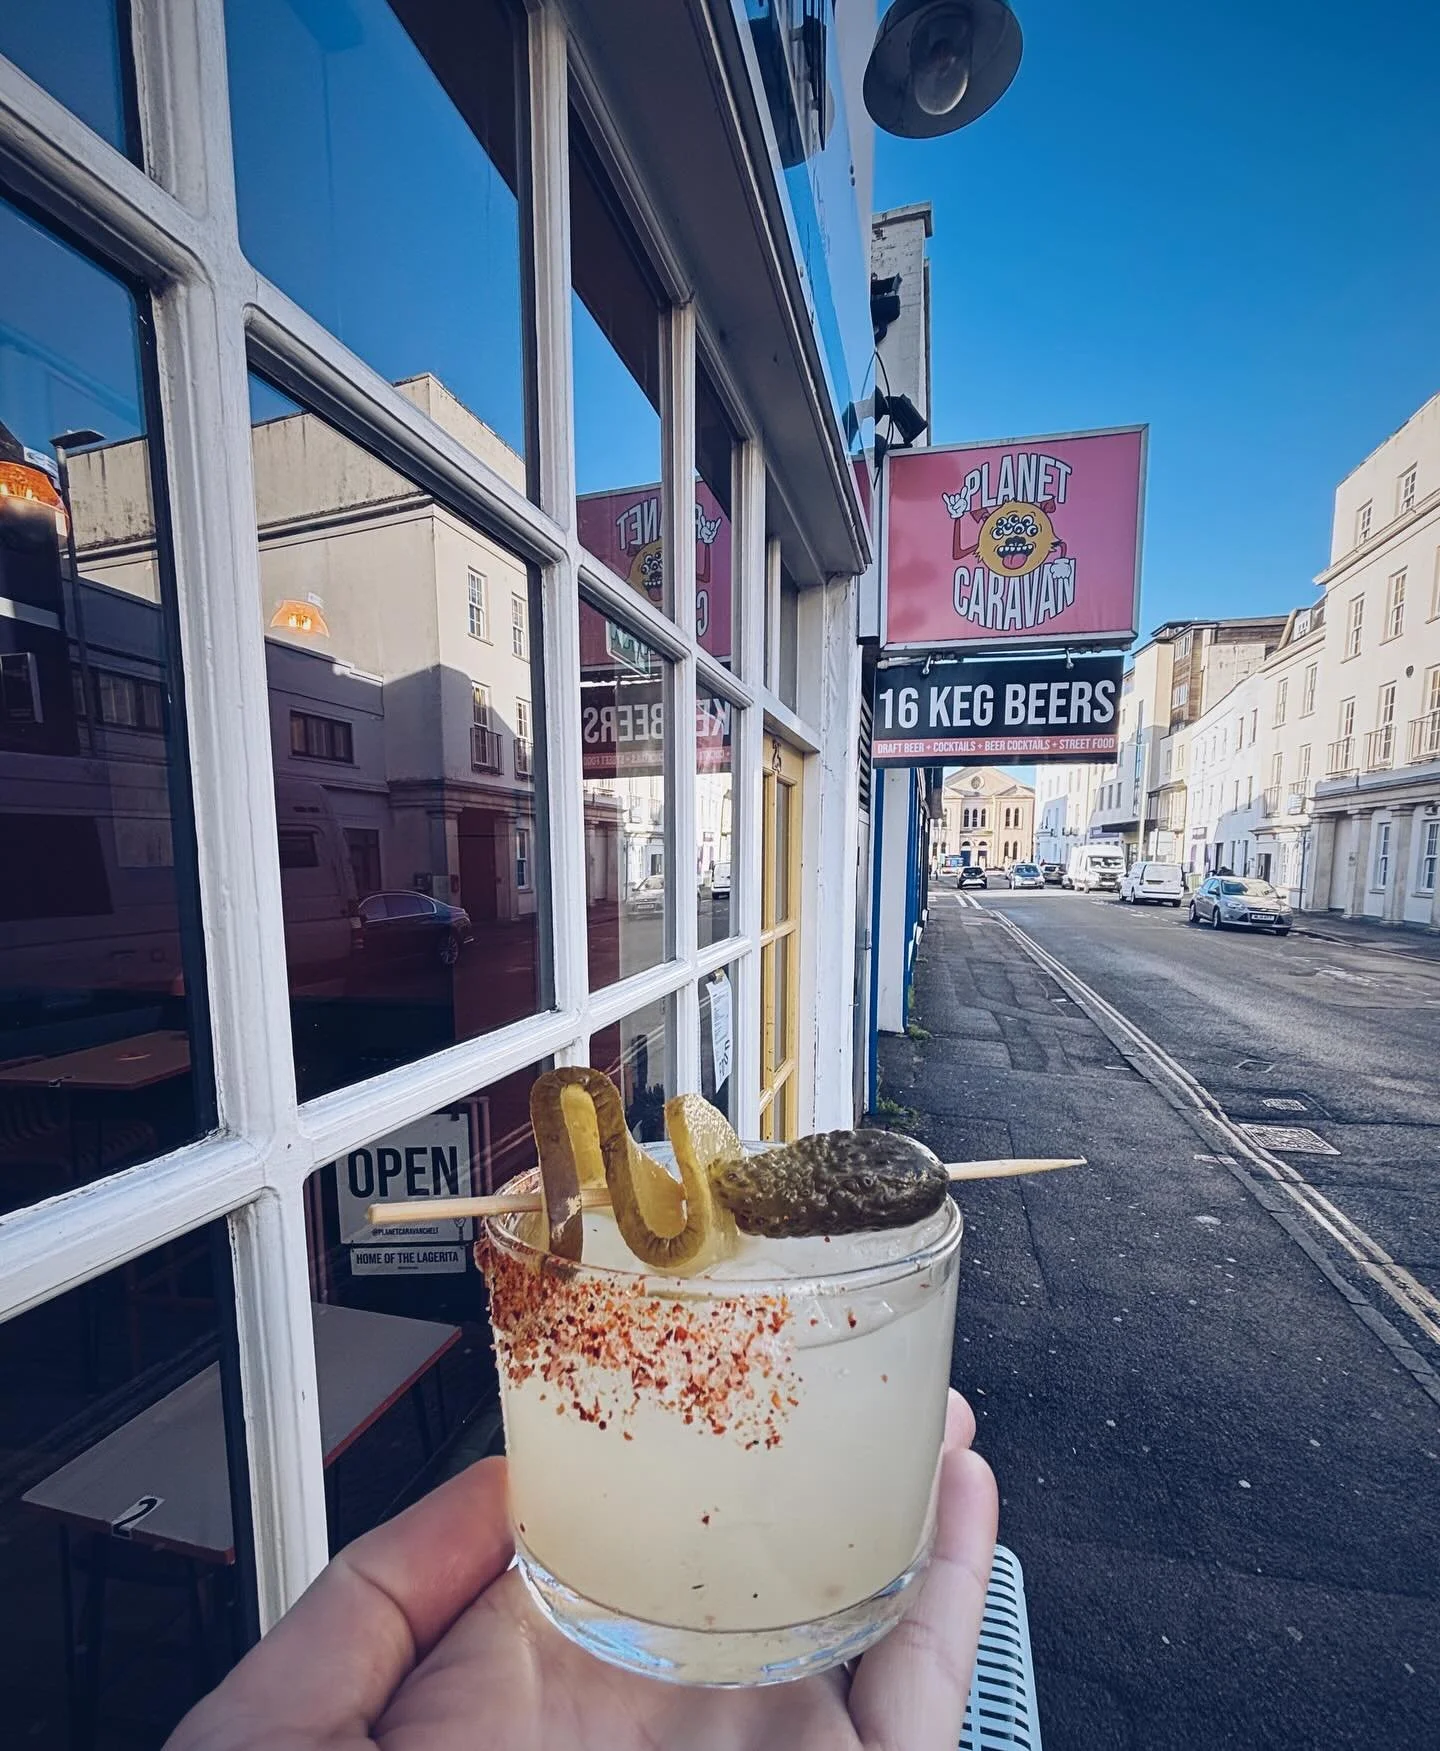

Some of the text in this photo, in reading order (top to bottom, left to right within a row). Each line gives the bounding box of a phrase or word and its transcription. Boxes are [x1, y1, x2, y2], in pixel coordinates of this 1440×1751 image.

[965, 453, 1072, 512] PLANET
[953, 558, 1076, 631] CARAVAN
[879, 680, 1116, 729] 16 KEG BEERS
[877, 743, 902, 754] DRAFT
[904, 742, 924, 753] BEER
[933, 741, 976, 752] COCKTAILS
[985, 740, 1005, 751] BEER
[1007, 739, 1050, 750] COCKTAILS
[1060, 738, 1091, 749] STREET
[1092, 737, 1114, 748] FOOD
[348, 1146, 459, 1198] OPEN
[356, 1251, 458, 1264] HOME OF THE LAGERITA
[113, 1498, 158, 1538] 2
